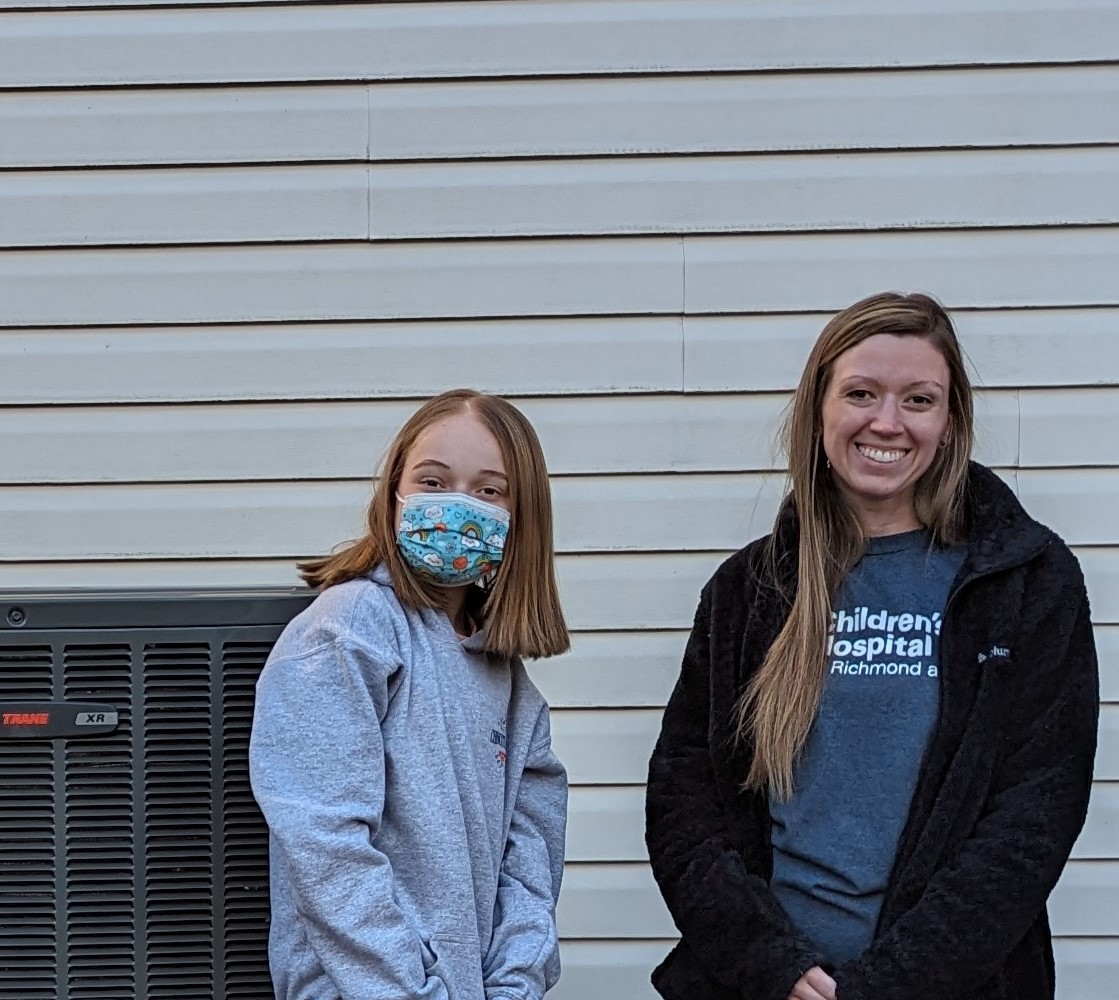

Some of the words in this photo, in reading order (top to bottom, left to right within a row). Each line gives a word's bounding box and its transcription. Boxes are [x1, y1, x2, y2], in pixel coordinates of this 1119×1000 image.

[830, 660, 922, 675] Richmond
[2, 713, 49, 725] TRANE
[85, 713, 105, 723] XR
